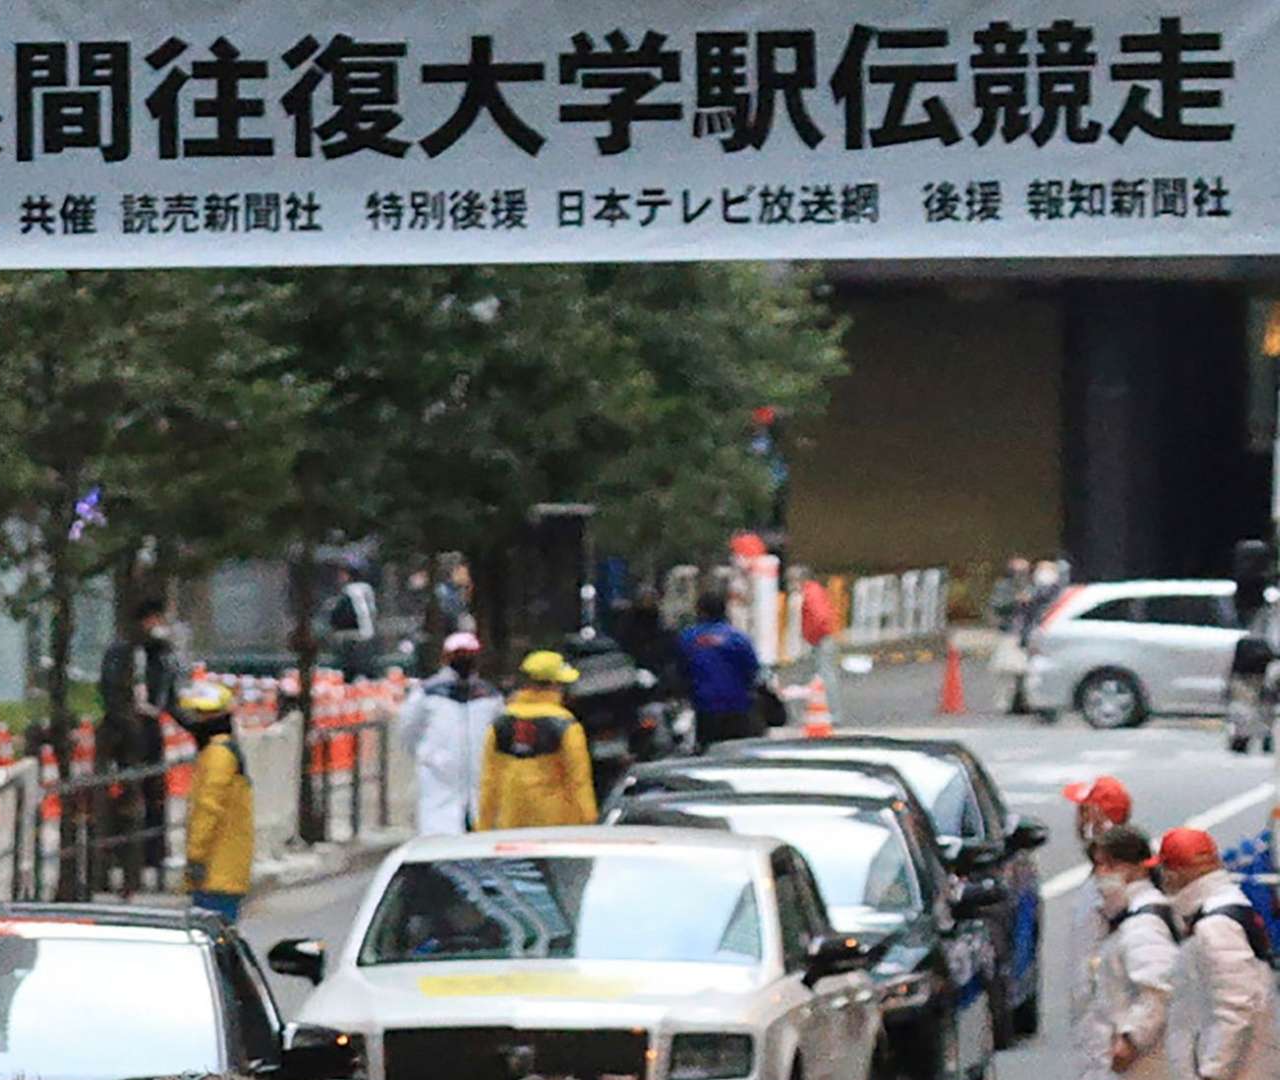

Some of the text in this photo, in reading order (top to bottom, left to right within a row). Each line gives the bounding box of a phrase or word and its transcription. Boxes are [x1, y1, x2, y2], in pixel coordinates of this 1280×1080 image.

[19, 193, 97, 235] 共催
[120, 191, 323, 234] 読売新聞社
[365, 188, 528, 231] 特別後援
[557, 184, 879, 227] 日本テレビ放送網
[922, 180, 1002, 223] 後援
[1026, 176, 1232, 220] 報知新聞社
